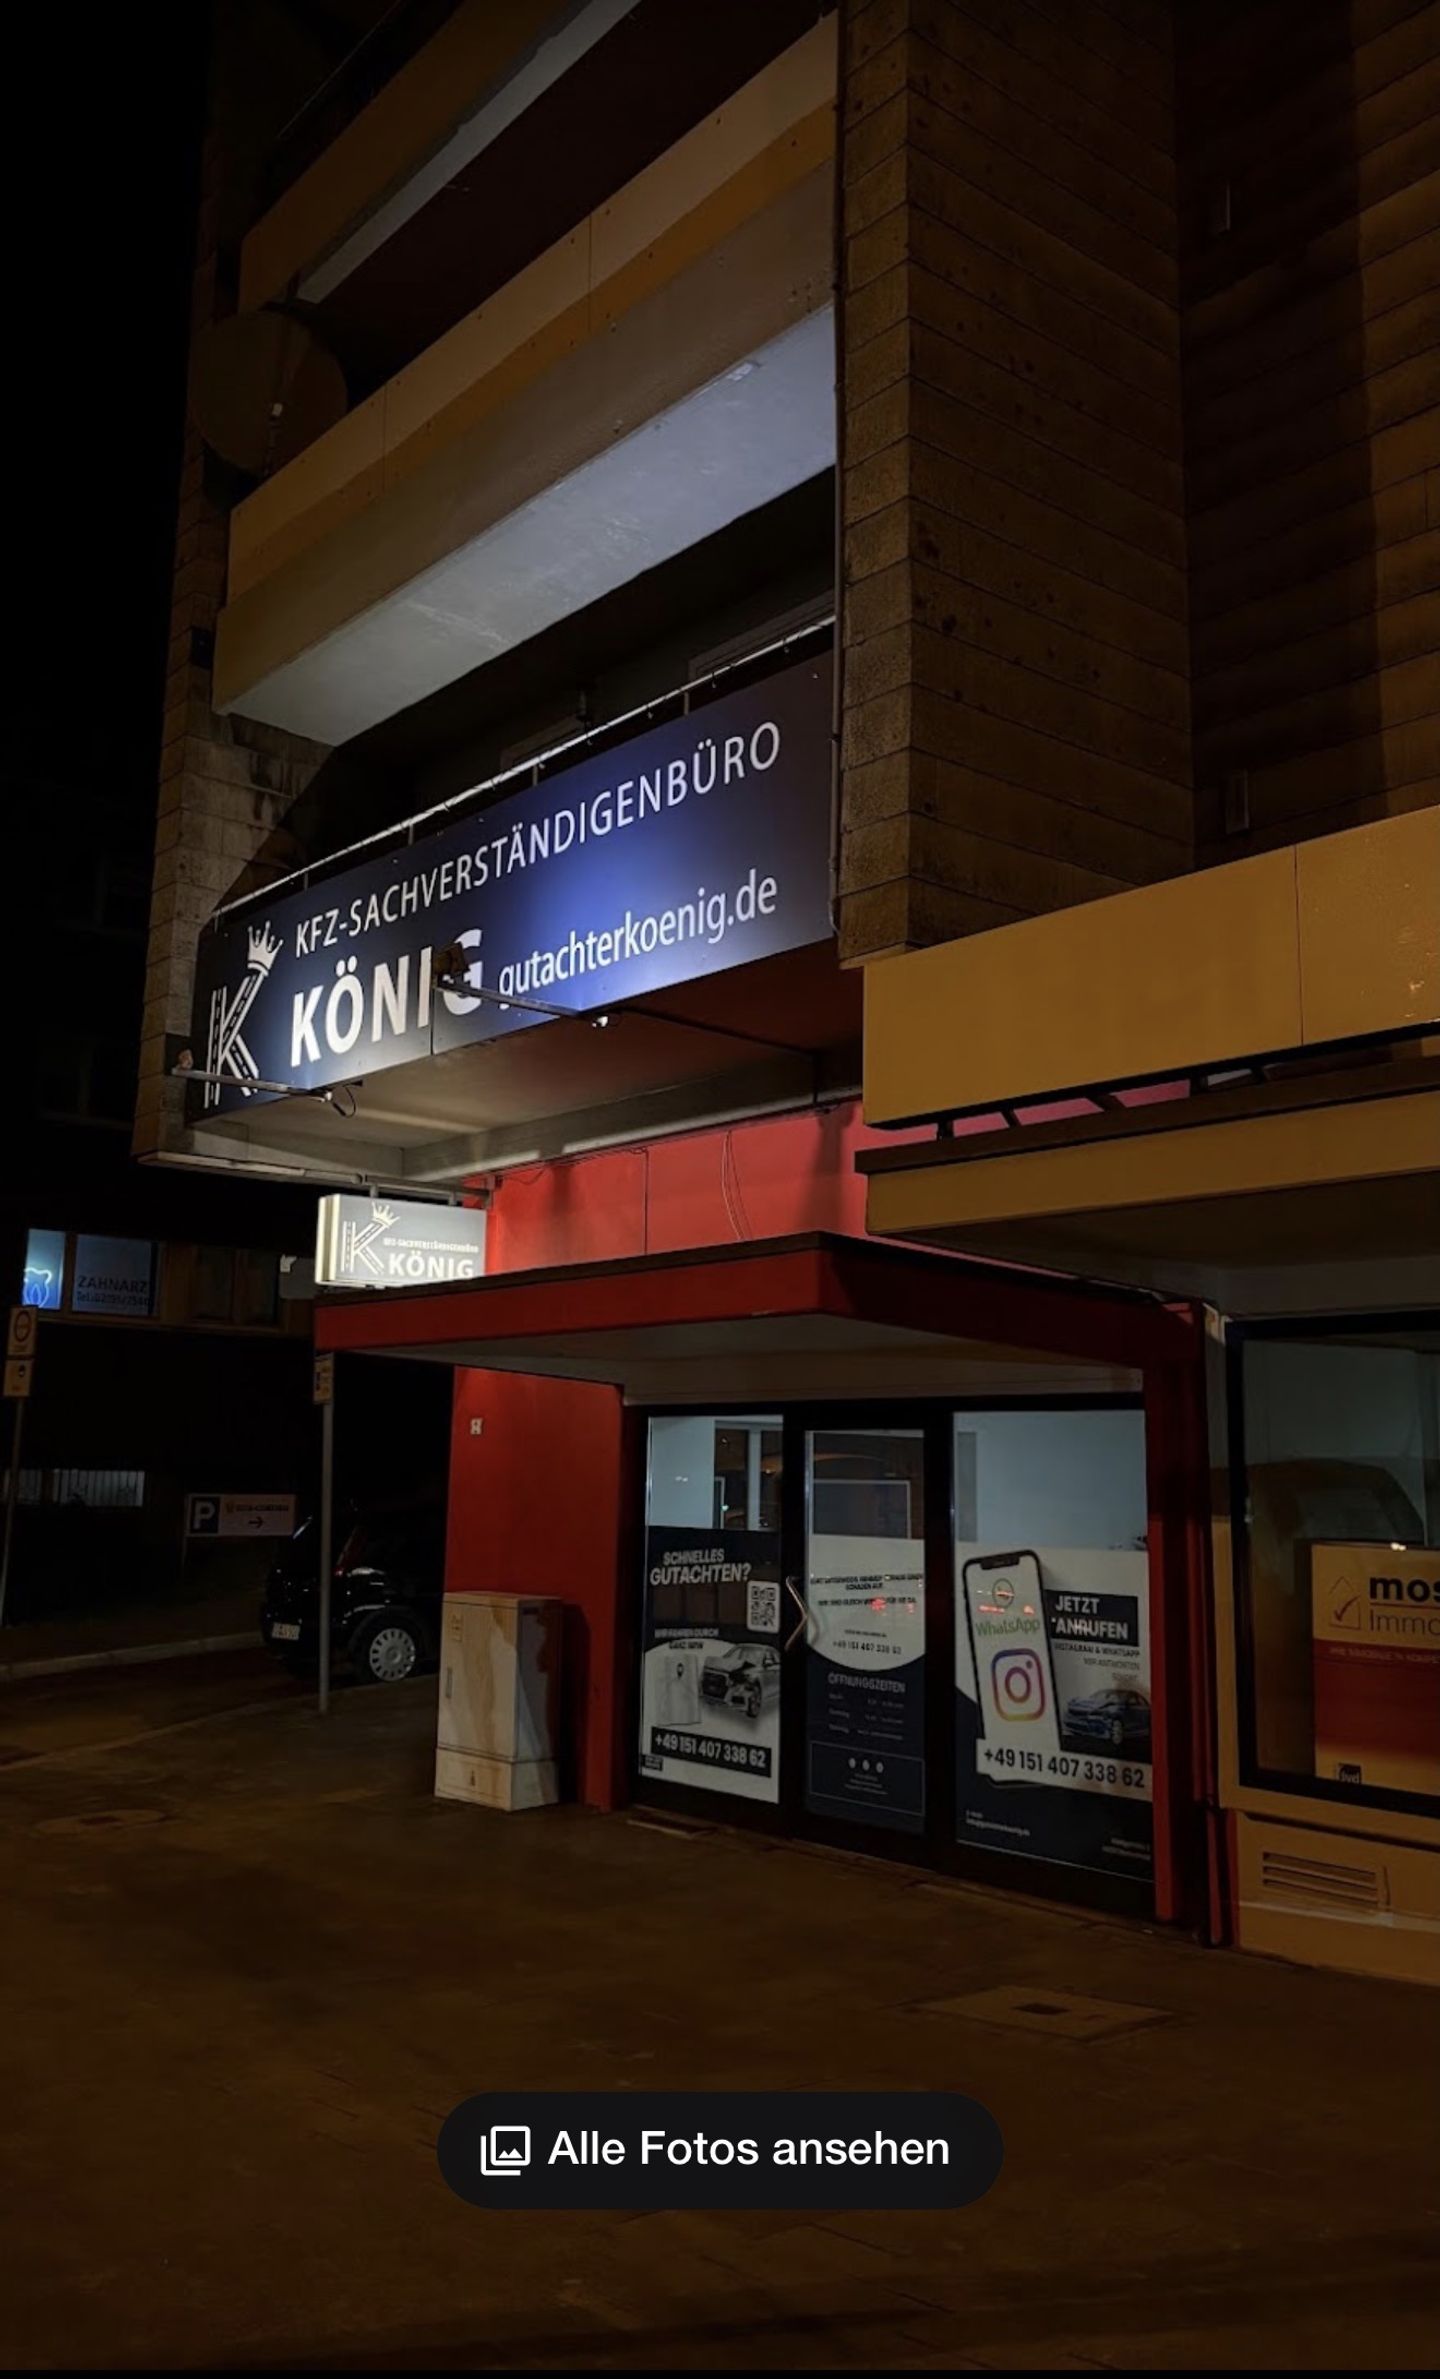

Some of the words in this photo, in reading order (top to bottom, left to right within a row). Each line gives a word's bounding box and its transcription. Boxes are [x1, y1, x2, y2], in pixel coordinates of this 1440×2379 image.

[295, 722, 780, 958] KFZ-SACHVERSTÄNDIGENBÜRO
[499, 869, 779, 1010] gutachterkoenig.de
[389, 1249, 474, 1279] KÖNIG
[77, 1275, 149, 1294] ZAHNARZ
[193, 1501, 217, 1531] P
[663, 1548, 725, 1566] SCHNELLES
[649, 1562, 752, 1586] GUTACHTEN?
[1055, 1595, 1100, 1614] JETZT
[975, 1617, 1041, 1636] WhatsApp
[1055, 1617, 1129, 1640] ANRUFEN
[655, 1733, 678, 1751] +49
[679, 1736, 697, 1755] 151
[698, 1740, 722, 1760] 407
[723, 1744, 748, 1765] 338
[749, 1748, 766, 1768] 62
[984, 1748, 1016, 1768] +49
[1019, 1751, 1043, 1772] 151
[1047, 1757, 1080, 1778] 407
[1084, 1761, 1117, 1784] 338
[1122, 1767, 1146, 1789] 62
